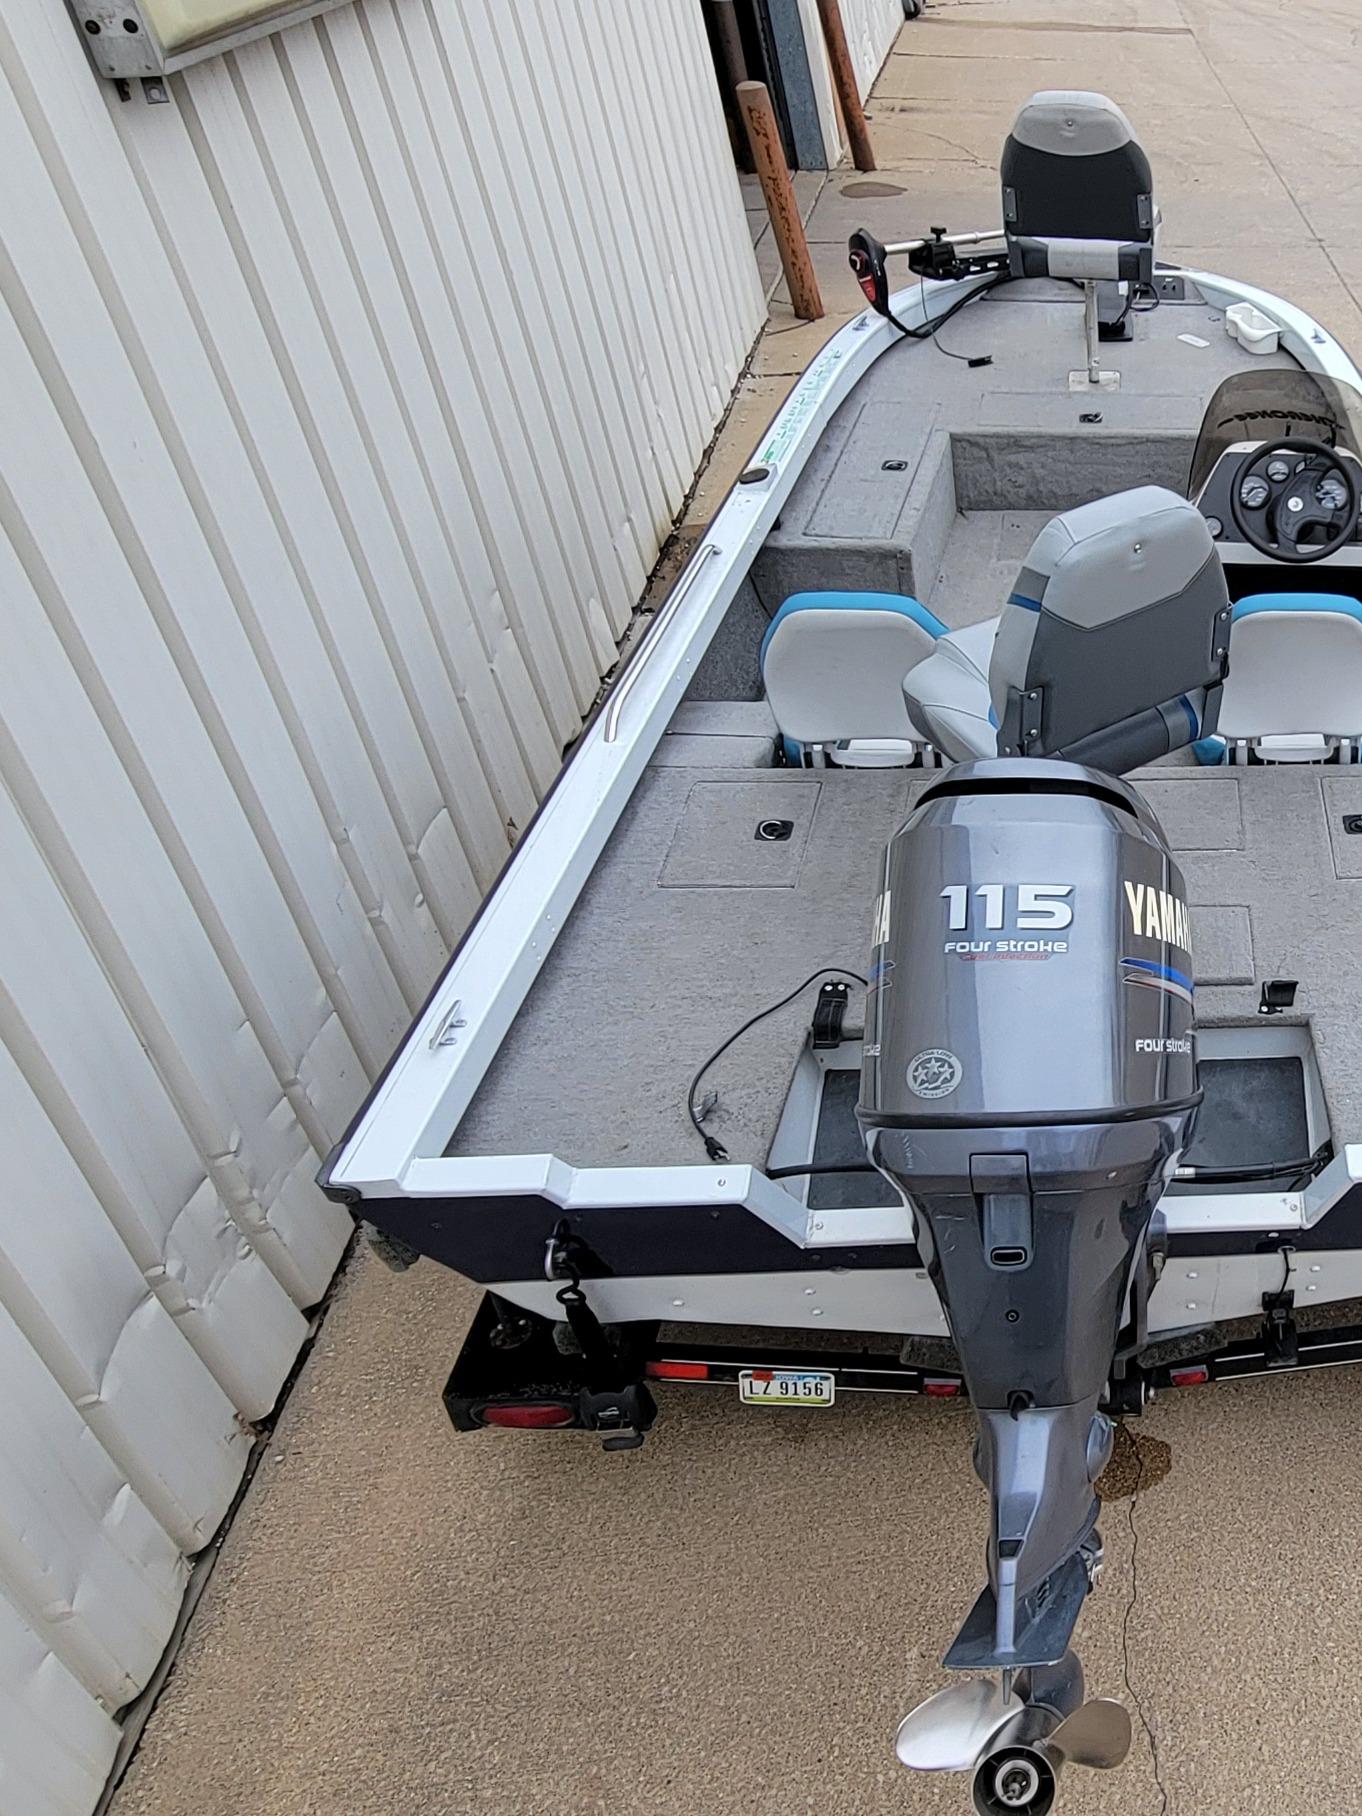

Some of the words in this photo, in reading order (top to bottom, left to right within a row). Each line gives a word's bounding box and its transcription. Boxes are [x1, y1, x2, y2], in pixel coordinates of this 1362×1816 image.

[939, 884, 1075, 931] 115
[1124, 880, 1192, 955] YAMAH
[749, 1380, 772, 1396] LZ
[780, 1381, 824, 1397] 9156
